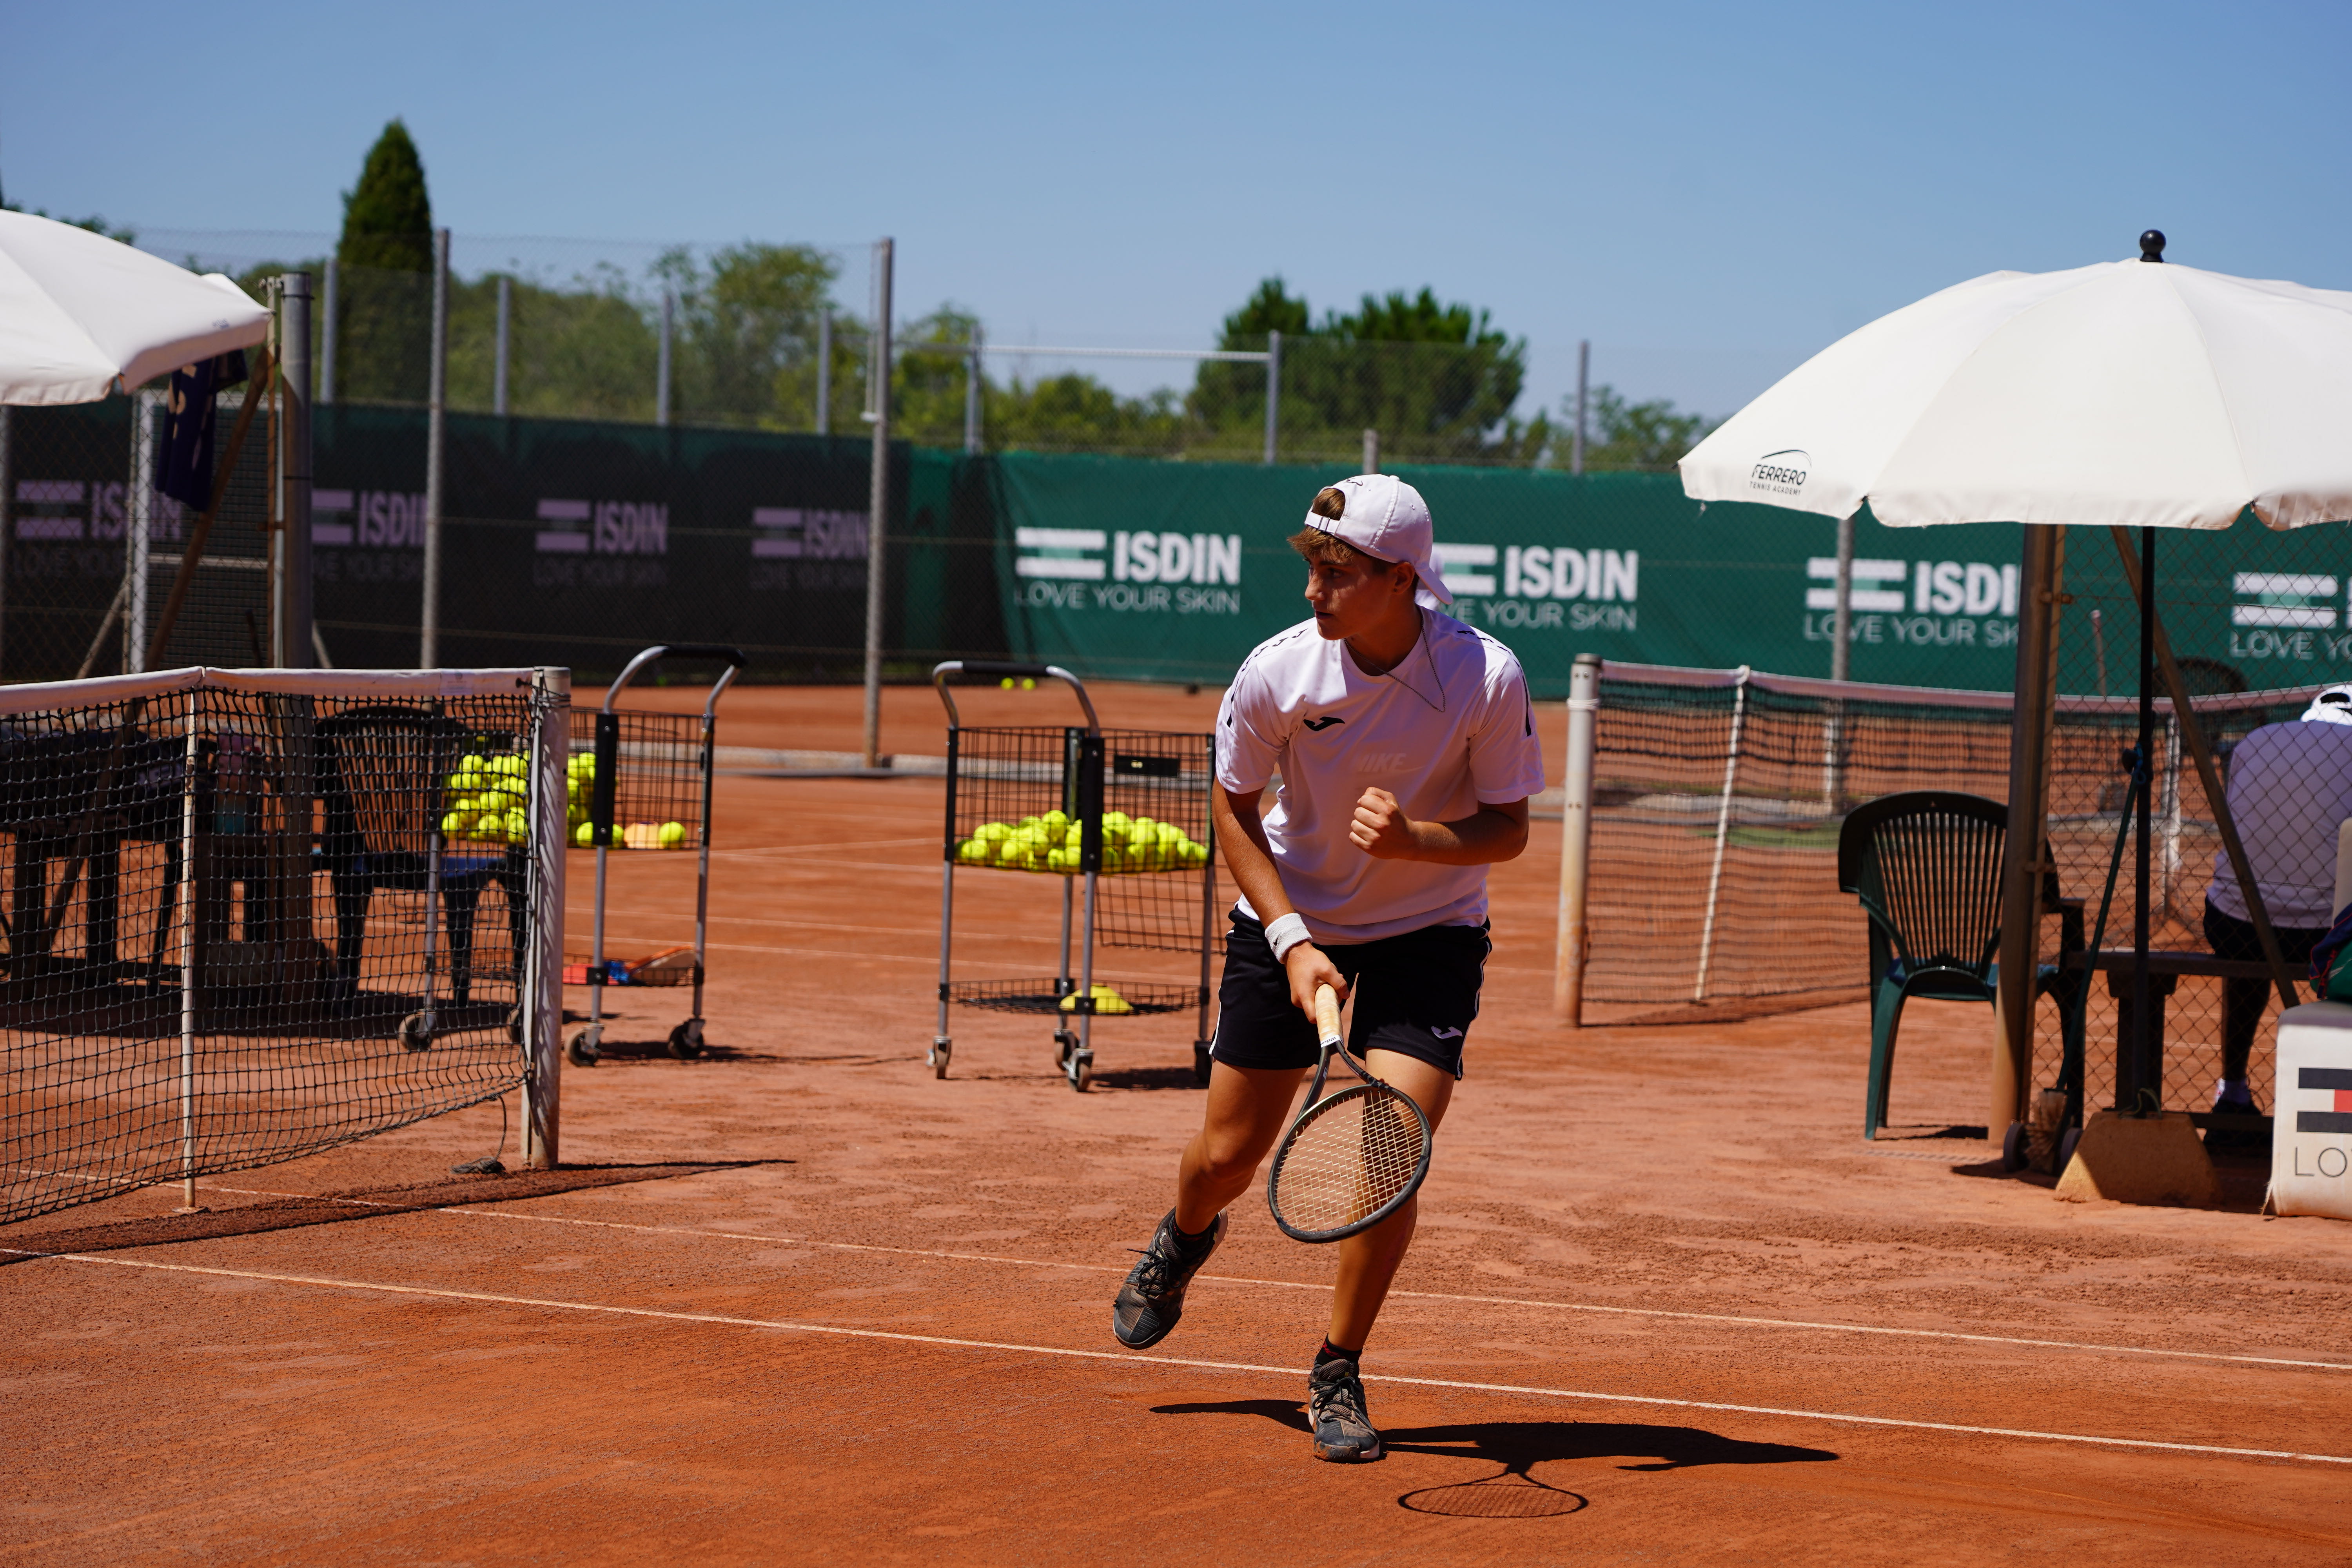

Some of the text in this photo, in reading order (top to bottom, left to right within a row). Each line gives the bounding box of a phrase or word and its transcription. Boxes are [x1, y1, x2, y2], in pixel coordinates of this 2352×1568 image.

[1751, 463, 1806, 485] FERRERO
[593, 500, 669, 555] ISDIN
[1112, 530, 1242, 585] ISDIN
[1504, 545, 1639, 602] ISDIN
[1091, 583, 1171, 613] YOUR
[1176, 586, 1241, 616] SKIN
[1914, 561, 2022, 617] ISDI
[1481, 599, 1564, 629] YOUR
[1569, 602, 1637, 632] SKIN
[1890, 616, 1976, 647] YOUR
[1982, 619, 2018, 649] SK
[2229, 630, 2315, 661] LOVE
[2296, 1147, 2352, 1178] LO
